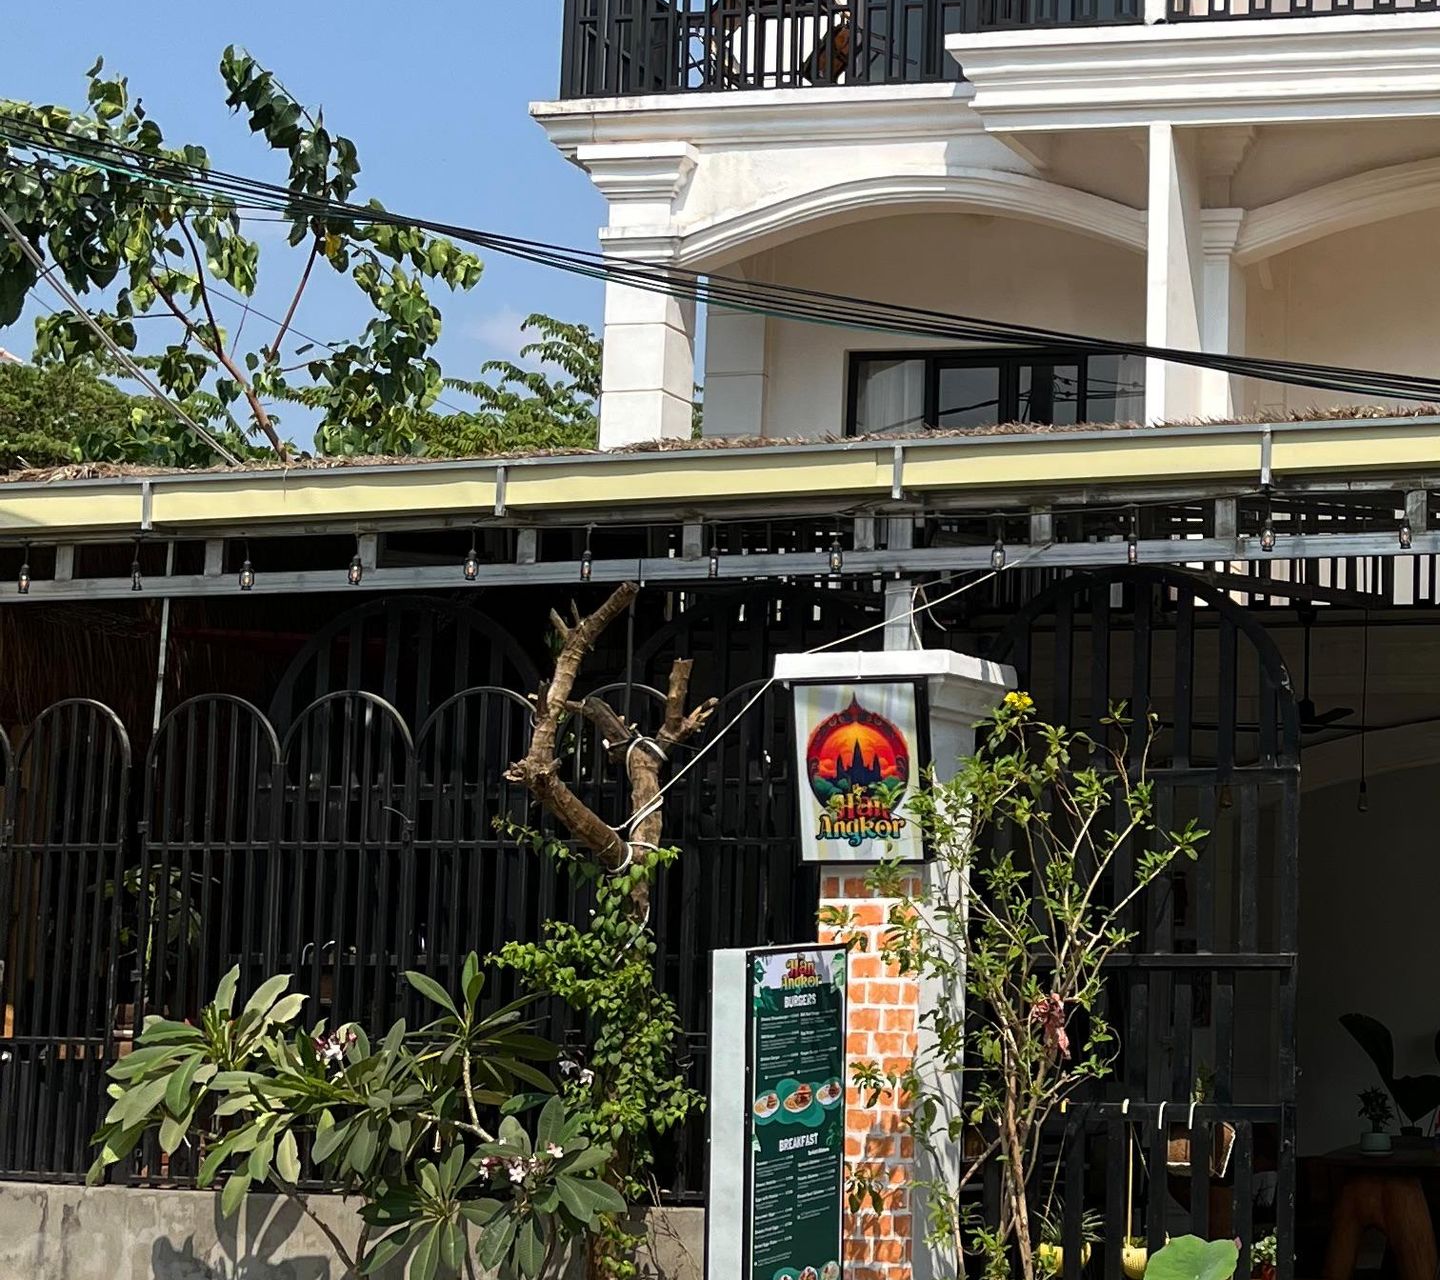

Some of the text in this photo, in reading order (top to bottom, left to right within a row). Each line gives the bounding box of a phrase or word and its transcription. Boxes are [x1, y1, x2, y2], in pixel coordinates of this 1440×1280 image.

[835, 791, 891, 821] Han
[815, 814, 907, 847] Angkor
[785, 957, 816, 978] Han
[780, 974, 823, 994] Angkor
[784, 993, 817, 1009] BURGERS
[778, 1132, 819, 1152] BREAKFAST
